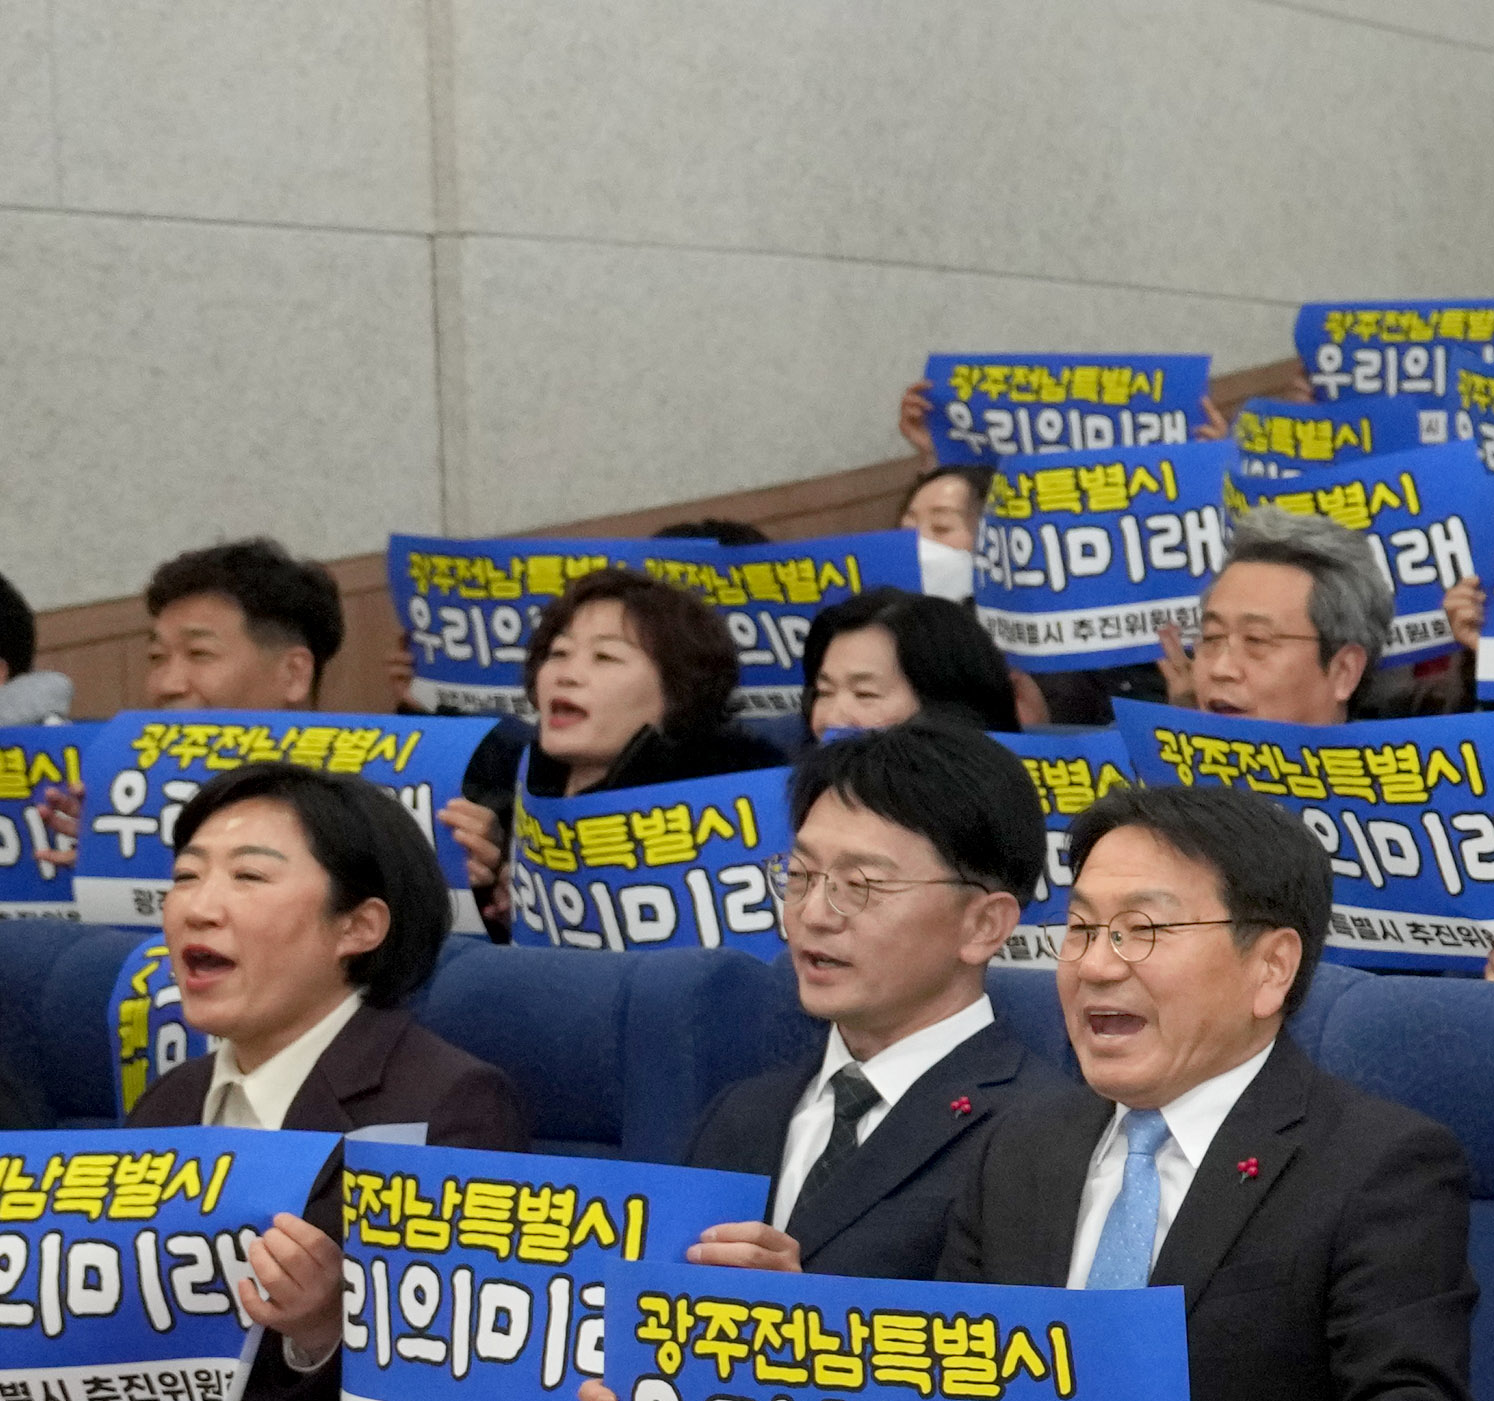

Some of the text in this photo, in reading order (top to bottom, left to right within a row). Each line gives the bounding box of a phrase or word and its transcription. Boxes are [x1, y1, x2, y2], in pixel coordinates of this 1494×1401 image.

[950, 366, 1163, 405] 광주전남특별시
[132, 724, 420, 774] 광주전남특별시
[1155, 730, 1484, 804] 광주전남특별시
[637, 1296, 1072, 1397] 광주전남특별시
